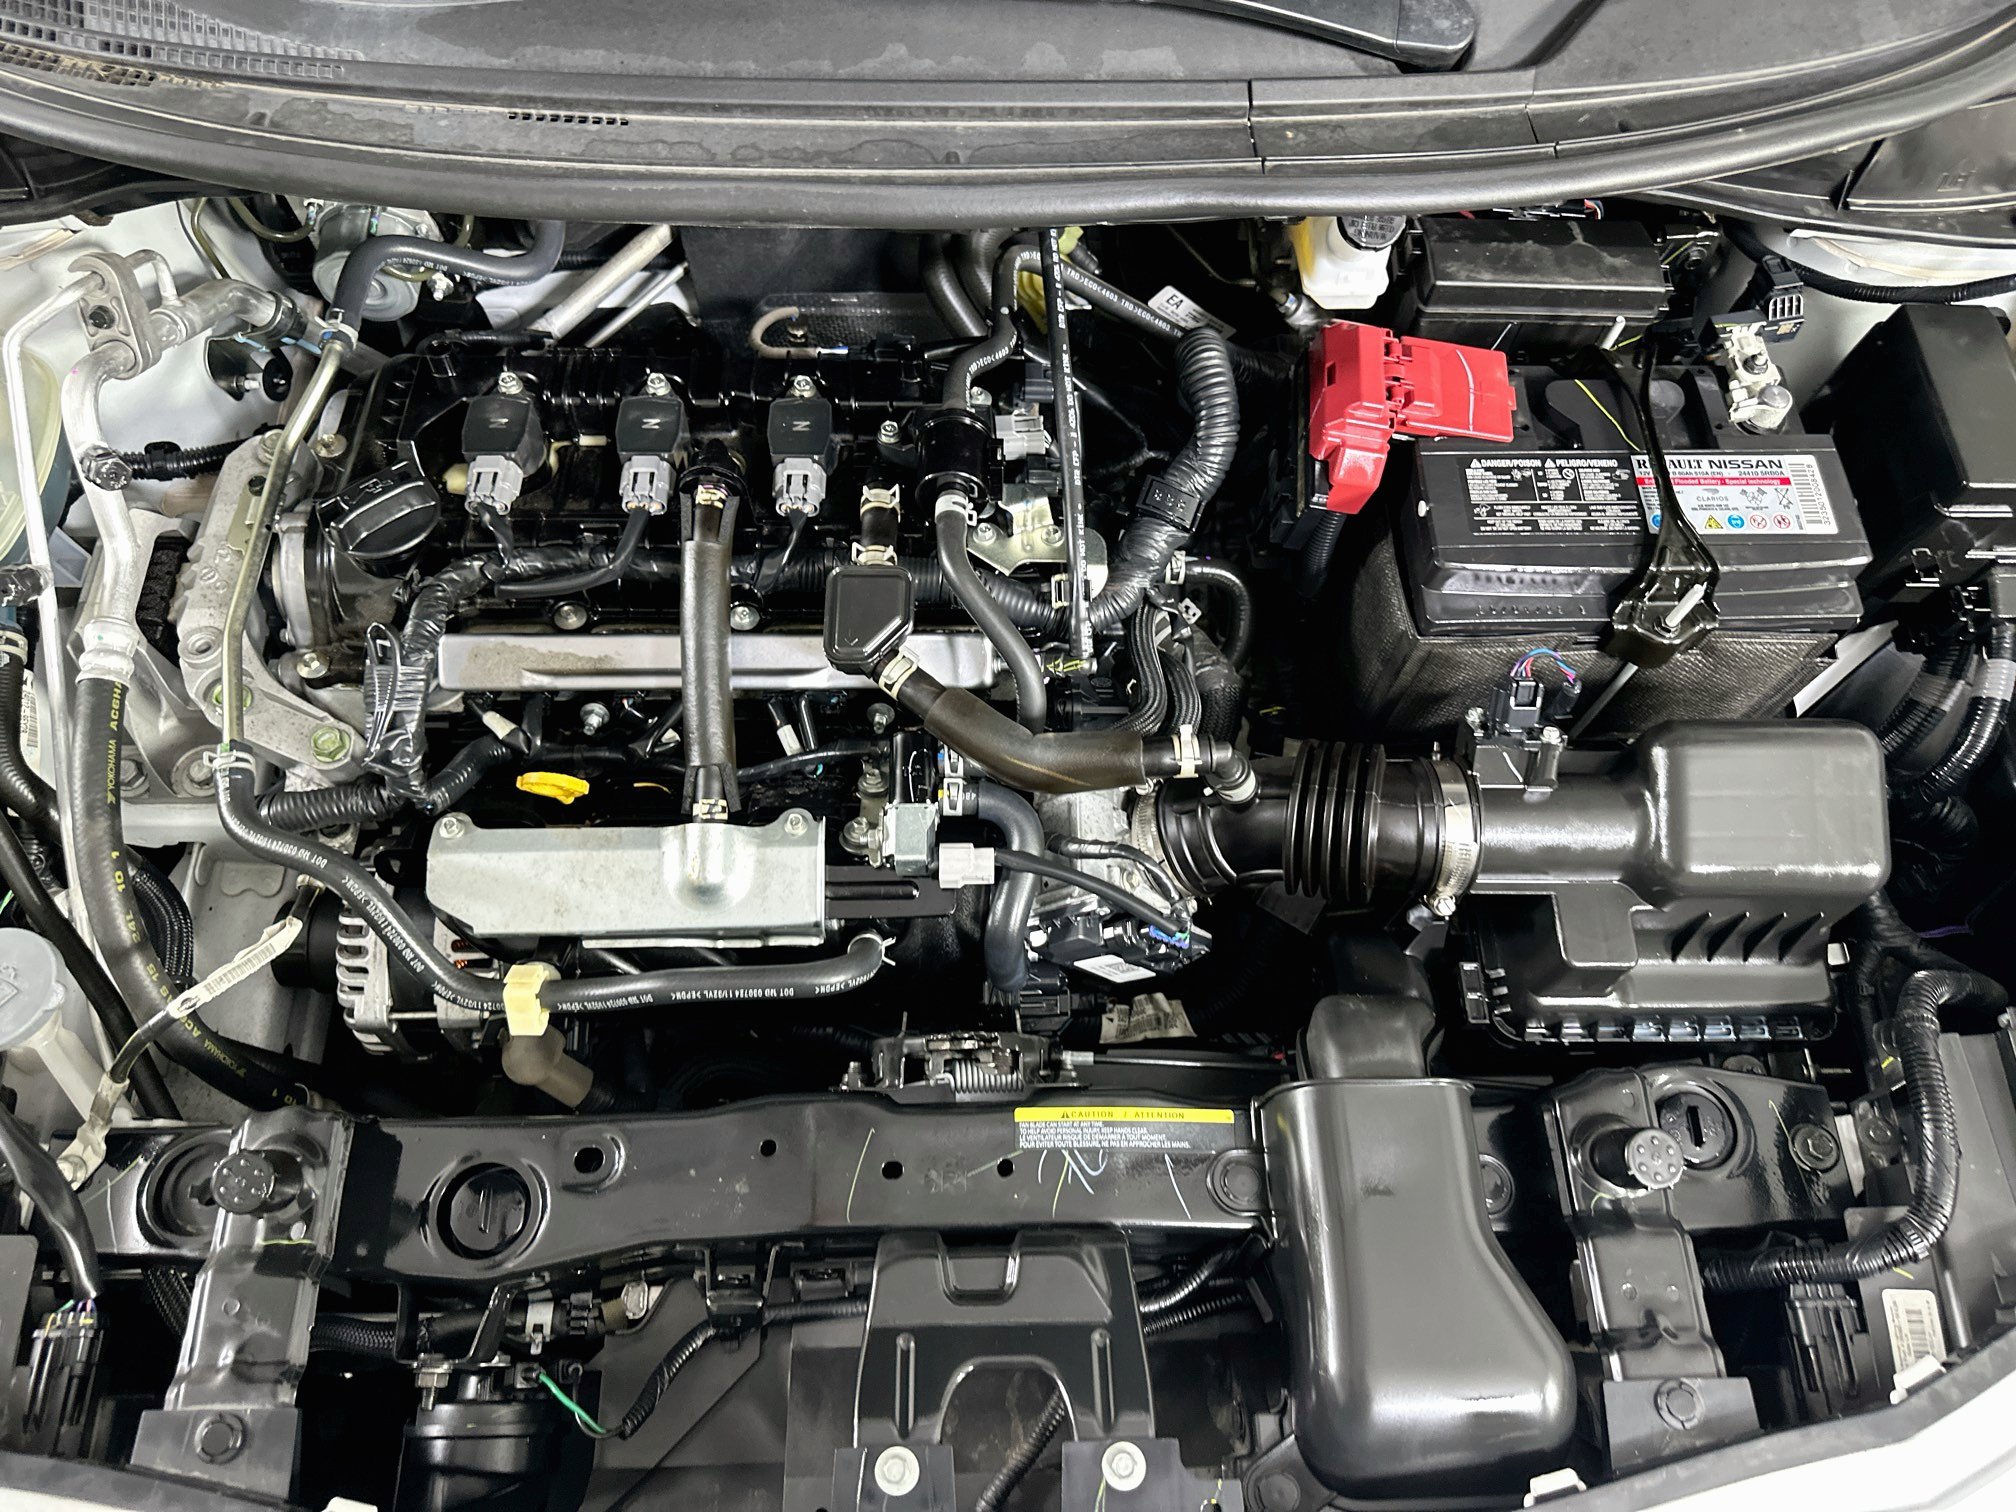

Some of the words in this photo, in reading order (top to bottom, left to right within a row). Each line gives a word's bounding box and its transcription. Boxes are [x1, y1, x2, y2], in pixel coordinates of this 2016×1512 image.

[1166, 294, 1184, 310] EA
[1637, 459, 1702, 469] RAULT
[1708, 460, 1783, 469] NISSAN
[107, 740, 117, 791] YOKOHAMA
[111, 850, 120, 860] 1
[311, 854, 327, 869] DOT
[114, 870, 126, 893] 10
[146, 963, 160, 982] 15
[780, 987, 794, 997] DOT
